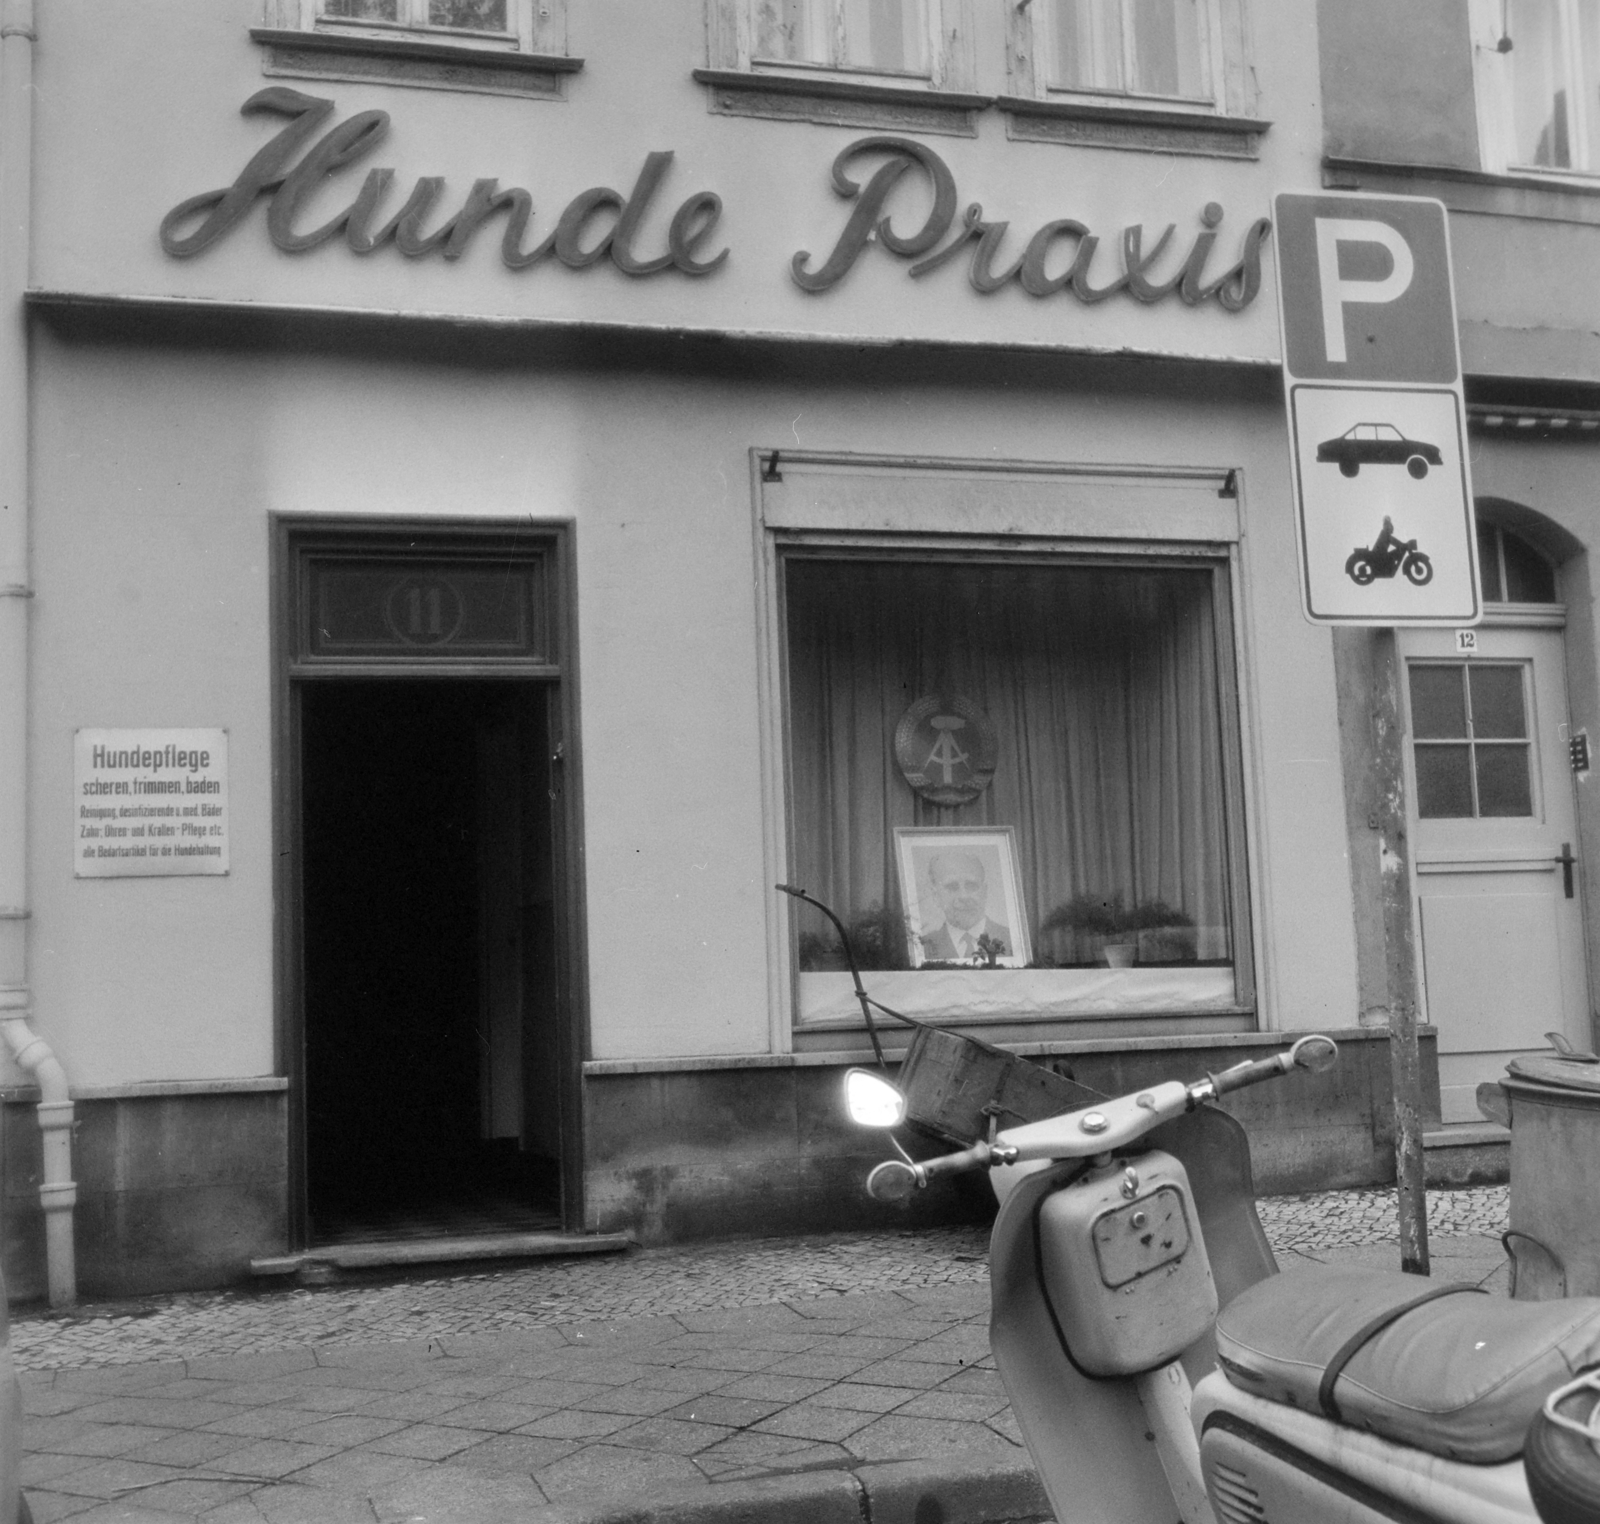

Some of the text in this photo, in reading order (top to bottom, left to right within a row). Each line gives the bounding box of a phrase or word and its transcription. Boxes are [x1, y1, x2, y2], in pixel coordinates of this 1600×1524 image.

[159, 86, 1272, 312] Hunde Praxis
[1315, 217, 1414, 363] P
[406, 588, 442, 634] 11
[1459, 632, 1475, 648] 12
[92, 744, 210, 773] Hundepflege
[186, 776, 221, 795] baden
[201, 803, 223, 817] Bäder
[131, 823, 145, 837] und
[209, 823, 224, 837] etc.
[82, 843, 222, 858] alle Bedarfsartikel für die Hundehaltung
